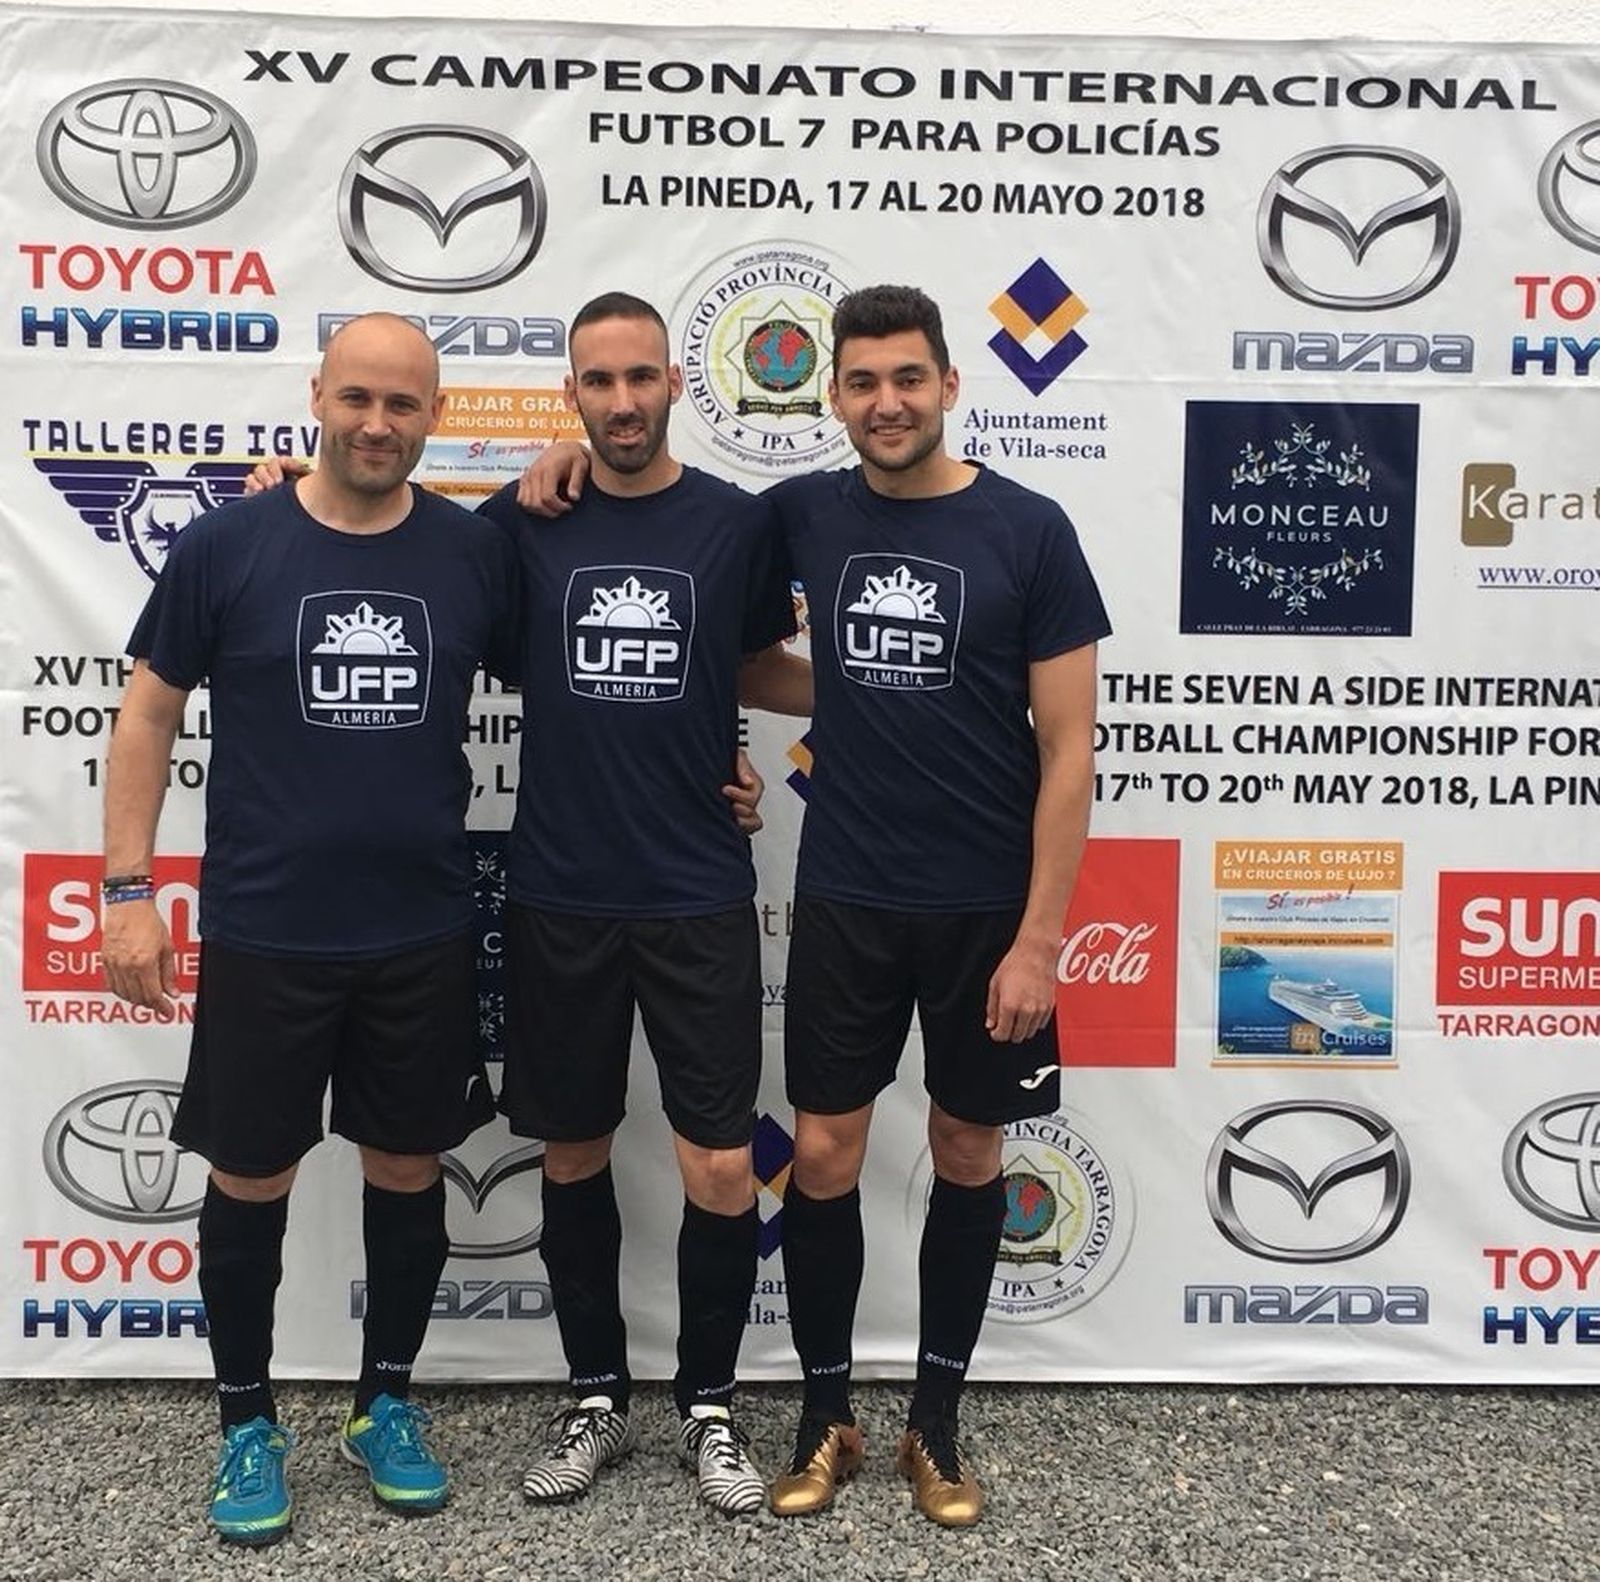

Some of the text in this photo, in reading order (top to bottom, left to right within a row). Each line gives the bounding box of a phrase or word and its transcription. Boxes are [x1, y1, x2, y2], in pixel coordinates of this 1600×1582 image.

[243, 50, 1557, 111] XV CAMPEONATO INTERNACIONAL
[589, 112, 1220, 157] FUTBOL 7 PARA POLICÍAS
[601, 173, 1206, 217] LA PINEDA, 17 AL 20 MAYO 2018
[19, 244, 276, 296] TOYOTA
[1514, 275, 1600, 320] TO
[21, 306, 279, 353] HYBRID
[23, 420, 224, 455] TALLERES
[446, 417, 524, 428] CRUCEROS
[529, 418, 548, 429] DE
[963, 408, 1108, 433] Ajuntament
[761, 434, 796, 450] IPA
[963, 437, 1106, 459] de Vila-seca
[1211, 503, 1389, 527] MONCEAU
[1267, 532, 1332, 543] FLEURS
[576, 637, 680, 675] UFP
[846, 623, 944, 664] UFP
[34, 656, 86, 686] XV
[312, 665, 418, 701] UFP
[1102, 674, 1173, 703] THE
[1183, 674, 1299, 705] SEVEN
[1309, 676, 1333, 705] A
[1345, 676, 1425, 706] SIDE
[1232, 724, 1518, 756] CHAMPIONSHIP
[1529, 727, 1600, 757] FOR
[1160, 773, 1209, 802] TO
[1219, 773, 1284, 803] 20th
[1293, 775, 1373, 804] MAY
[1381, 776, 1478, 809] 2018,
[1489, 776, 1534, 805] LA
[1544, 777, 1600, 806] PIN
[1222, 849, 1395, 866] ¿VIAJAR GRATIS
[1223, 869, 1241, 880] EN
[1246, 869, 1322, 880] CRUCEROS
[1326, 871, 1344, 881] DE
[1348, 871, 1383, 881] LUJO
[1057, 922, 1158, 985] Cola
[1459, 966, 1600, 989] SUPERME
[1322, 1030, 1387, 1046] Cruises
[1437, 1014, 1600, 1037] TARRAGON
[1074, 1146, 1110, 1271] TARRAGONA
[23, 1238, 200, 1284] TOYO
[1483, 1248, 1600, 1291] TOY
[1003, 1282, 1035, 1298] IPA
[23, 1299, 211, 1338] HYBR
